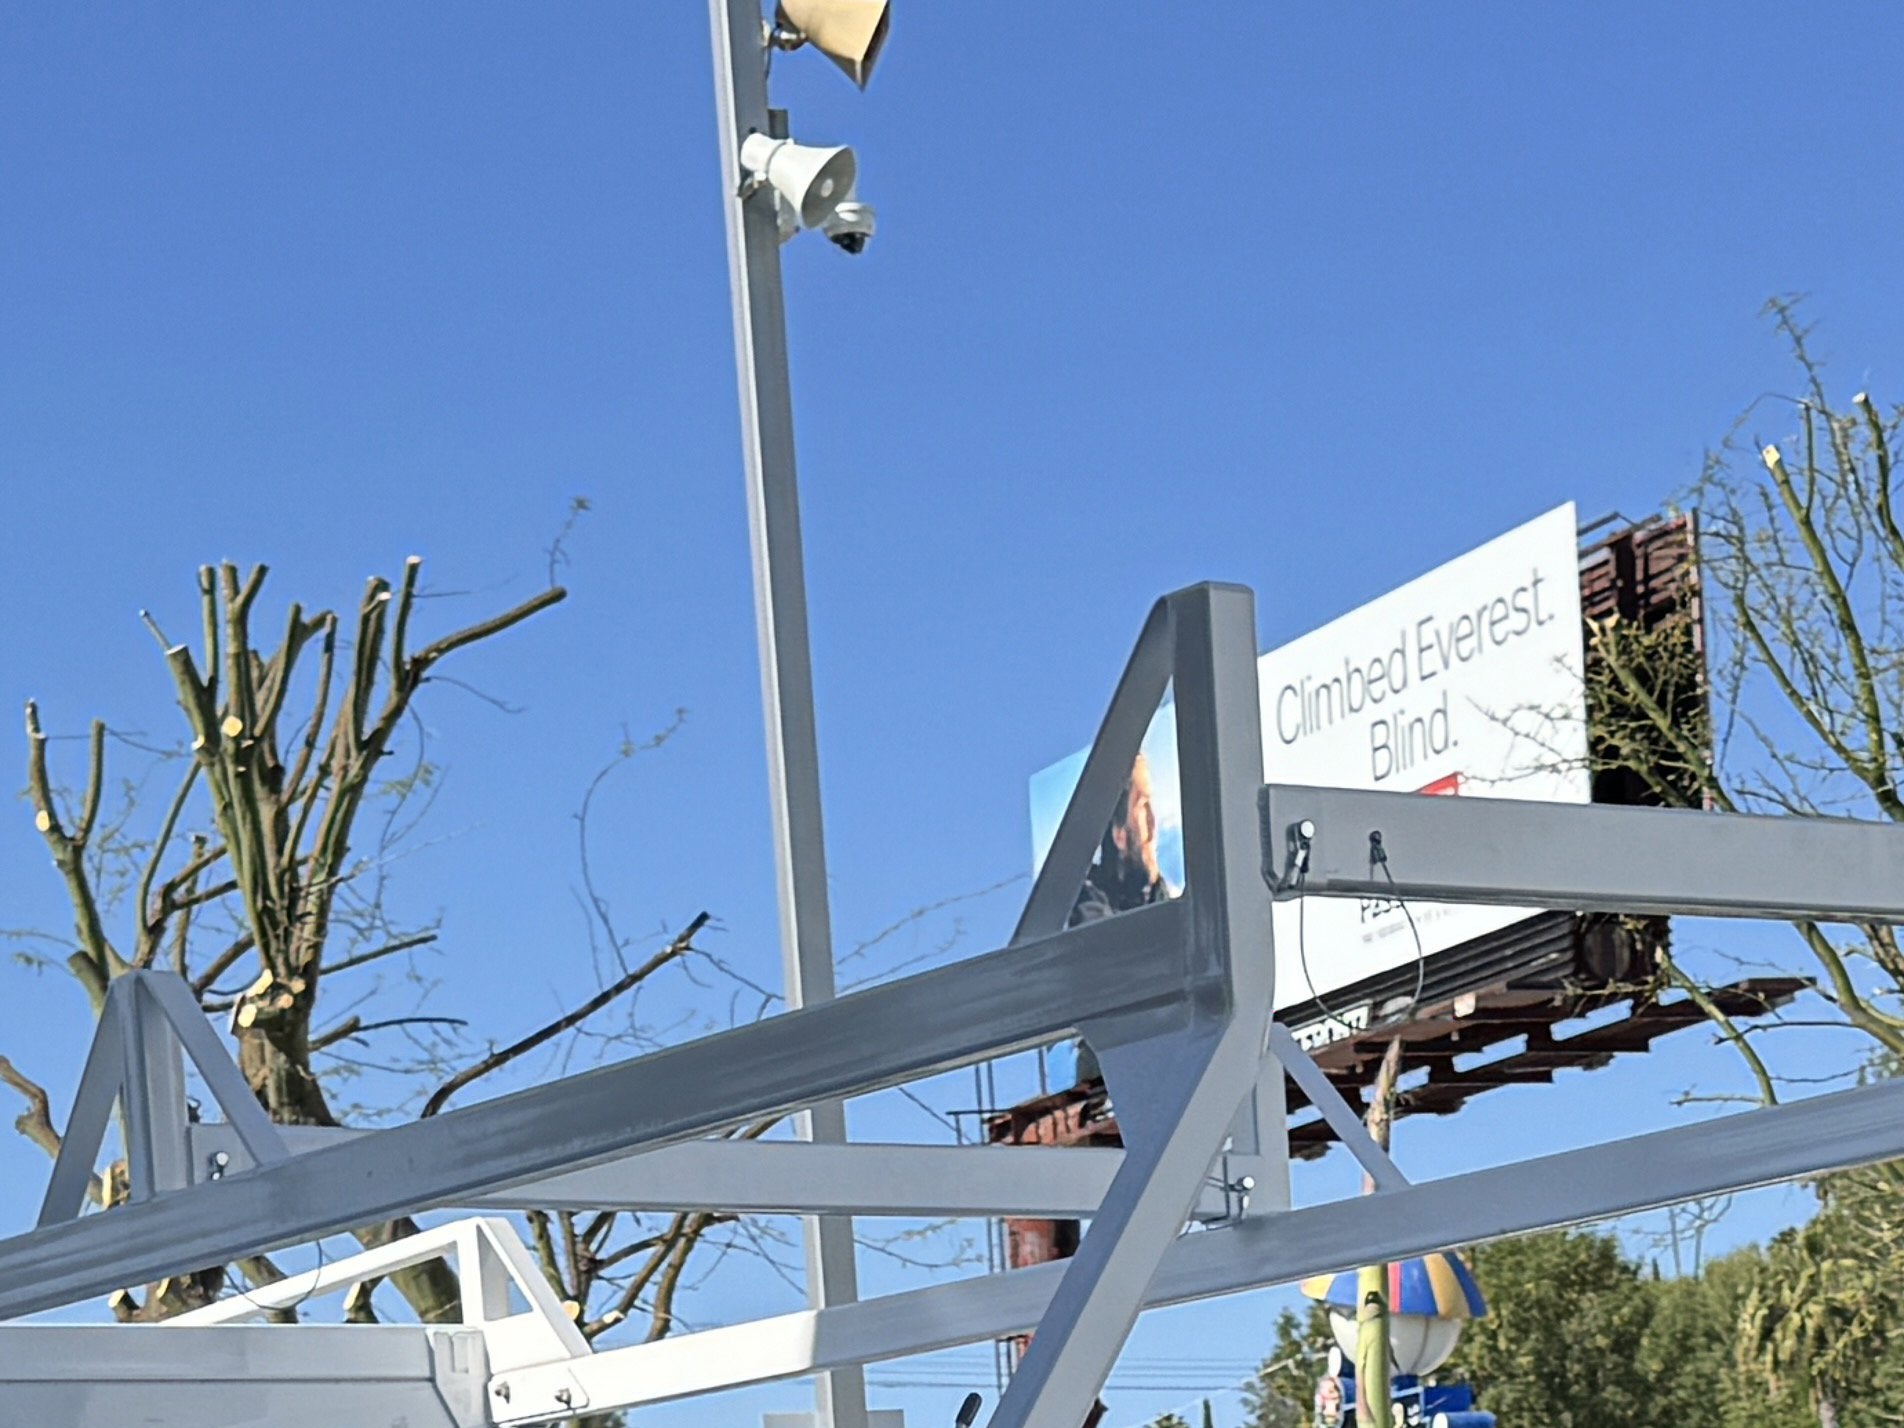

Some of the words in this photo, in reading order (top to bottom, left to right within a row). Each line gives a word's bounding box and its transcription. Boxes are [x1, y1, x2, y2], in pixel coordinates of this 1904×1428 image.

[1276, 628, 1408, 745] Climbed
[1416, 567, 1555, 682] Everest.
[1371, 688, 1458, 782] Blind.
